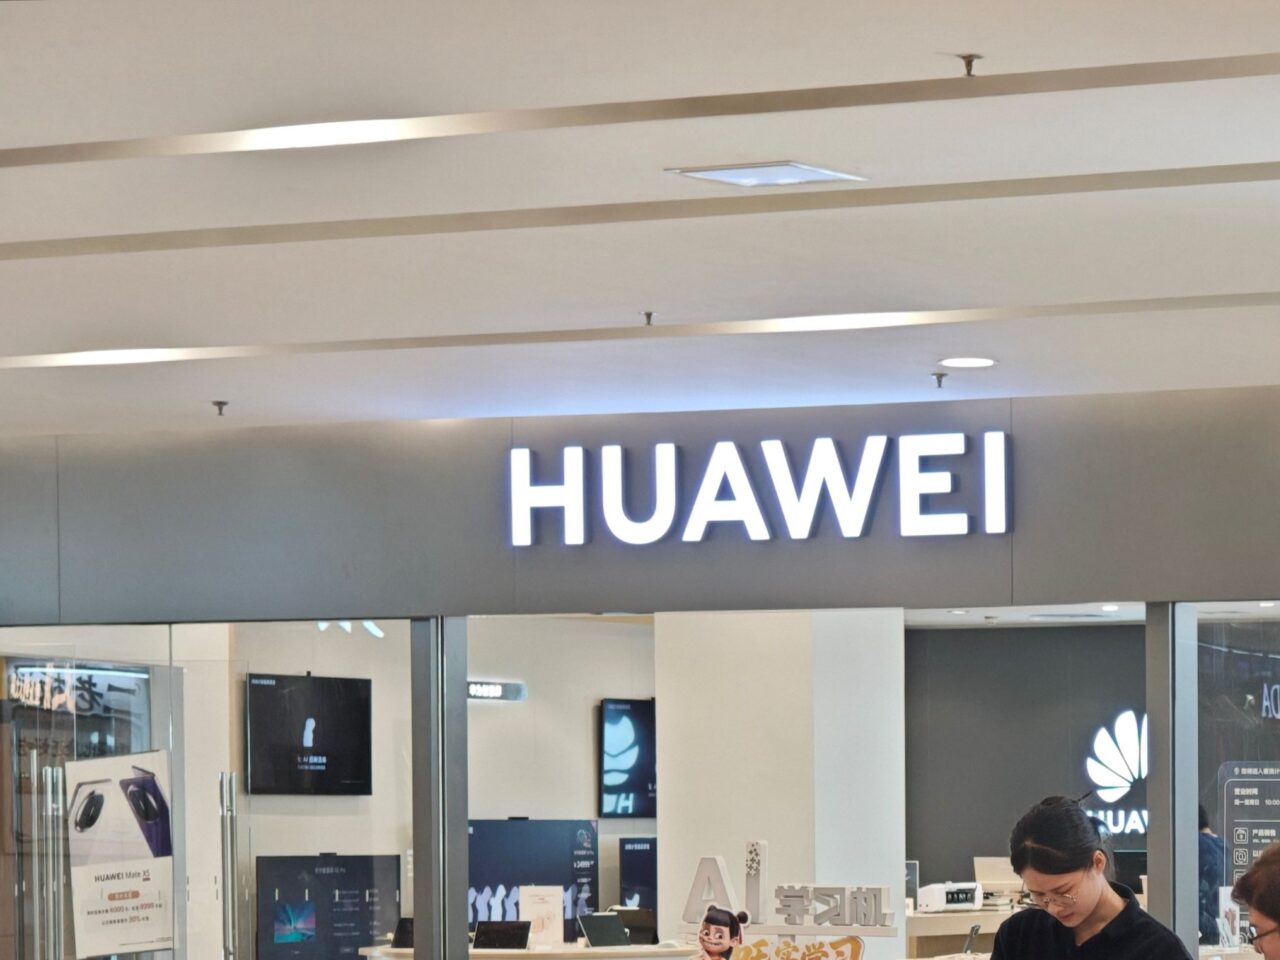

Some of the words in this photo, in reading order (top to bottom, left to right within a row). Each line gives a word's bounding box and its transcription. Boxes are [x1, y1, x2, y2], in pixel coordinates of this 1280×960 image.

[510, 431, 1006, 546] HUAWEI
[95, 872, 124, 882] HUAWEI
[775, 885, 895, 927] 学习机
